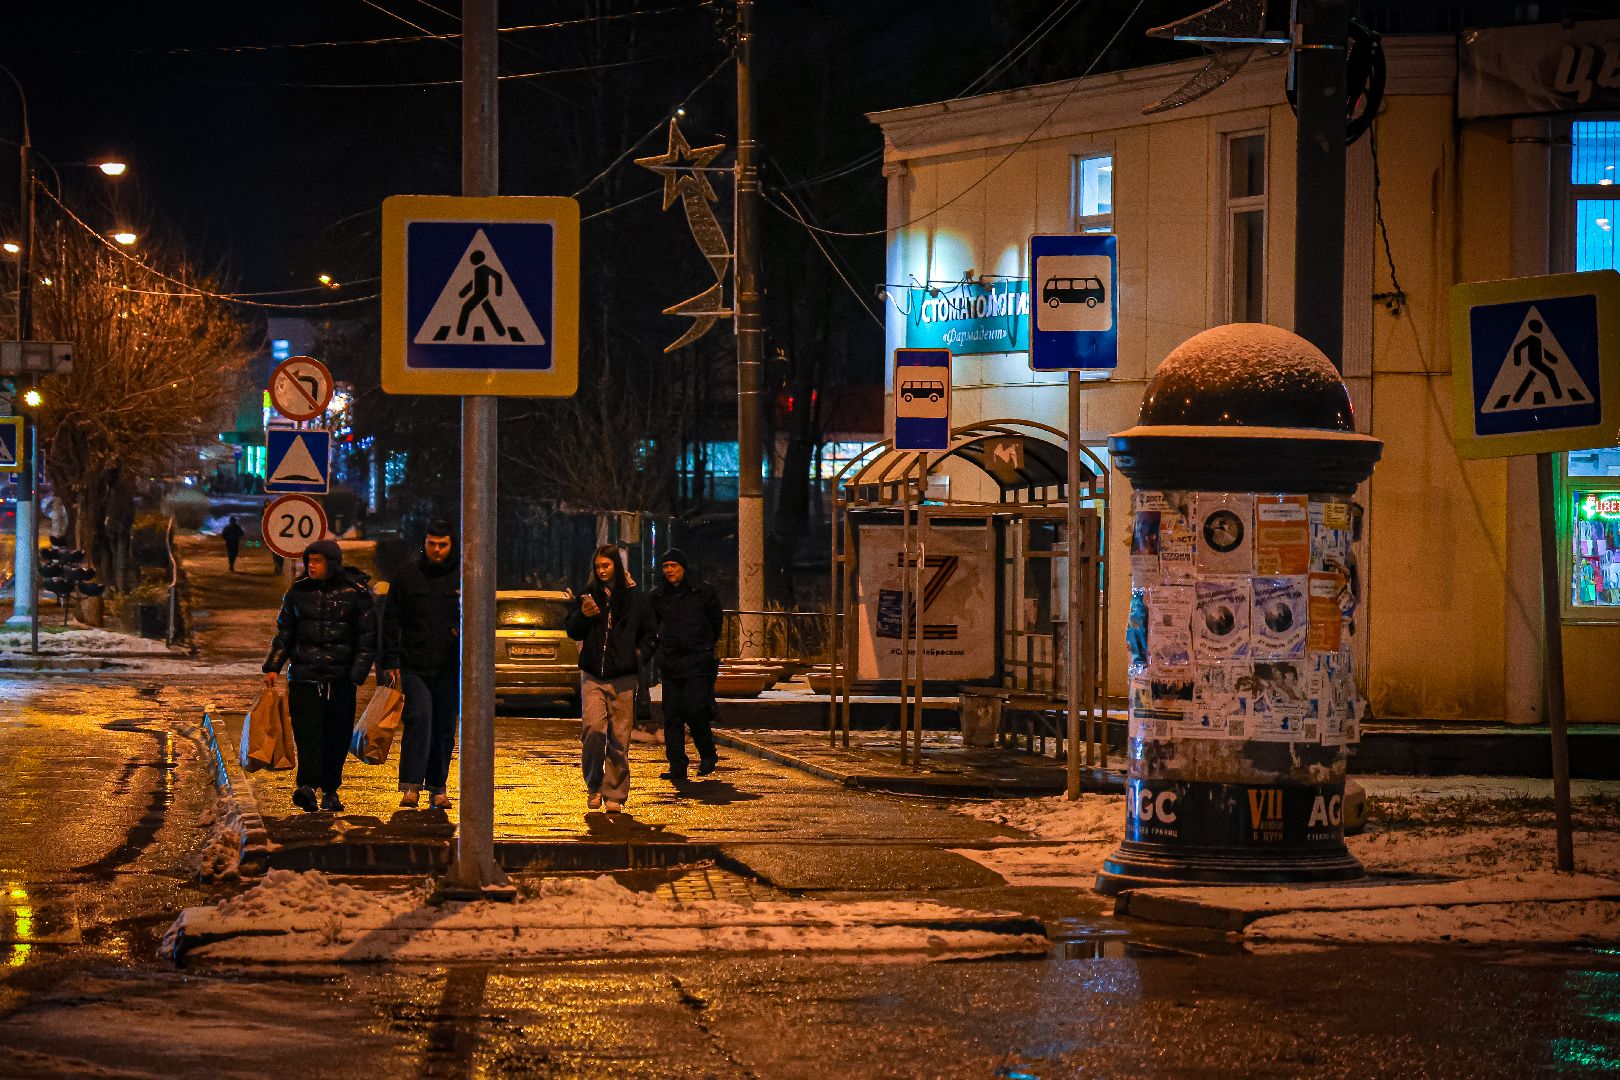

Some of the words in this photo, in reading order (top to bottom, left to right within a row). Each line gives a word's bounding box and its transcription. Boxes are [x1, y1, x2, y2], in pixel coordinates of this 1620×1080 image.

[922, 291, 1029, 323] СТОМАТОЛОГИ
[279, 514, 314, 539] 20
[1247, 788, 1284, 830] VII
[1151, 828, 1178, 838] ГРАНИЦ
